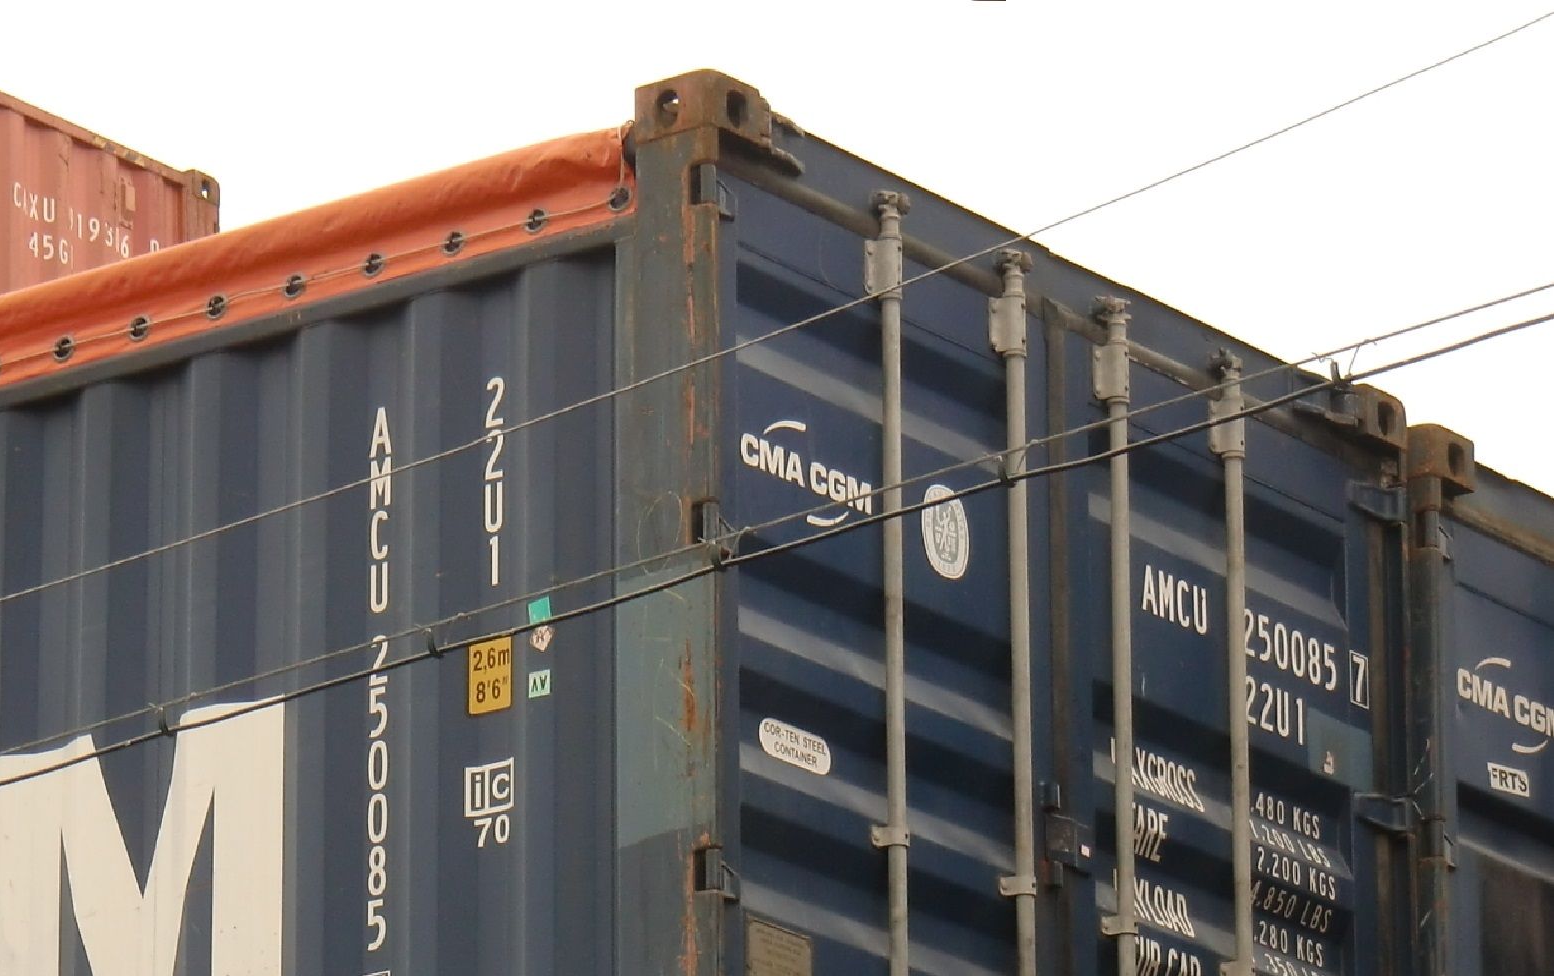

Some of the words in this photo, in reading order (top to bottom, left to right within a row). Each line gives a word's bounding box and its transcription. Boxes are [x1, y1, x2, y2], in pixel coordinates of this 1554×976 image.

[484, 376, 506, 587] 22U1
[740, 433, 806, 488] CMA
[809, 460, 873, 516] CGM
[368, 406, 392, 614] AMCU
[1142, 563, 1208, 636] AMCU
[1245, 607, 1338, 691] 250085
[1350, 652, 1368, 706] 7
[1246, 675, 1304, 746] 22U1
[1456, 667, 1511, 719] CMA
[763, 721, 801, 746] COR-TEN
[802, 736, 827, 757] STEEL
[773, 740, 818, 768] CONTAINER
[365, 634, 389, 952] 250085
[1292, 806, 1321, 840] KGS
[473, 813, 511, 848] 70
[1132, 802, 1169, 863] ARE
[1308, 865, 1337, 901] KGS
[1300, 899, 1333, 934] LBS
[1295, 933, 1324, 968] KGS
